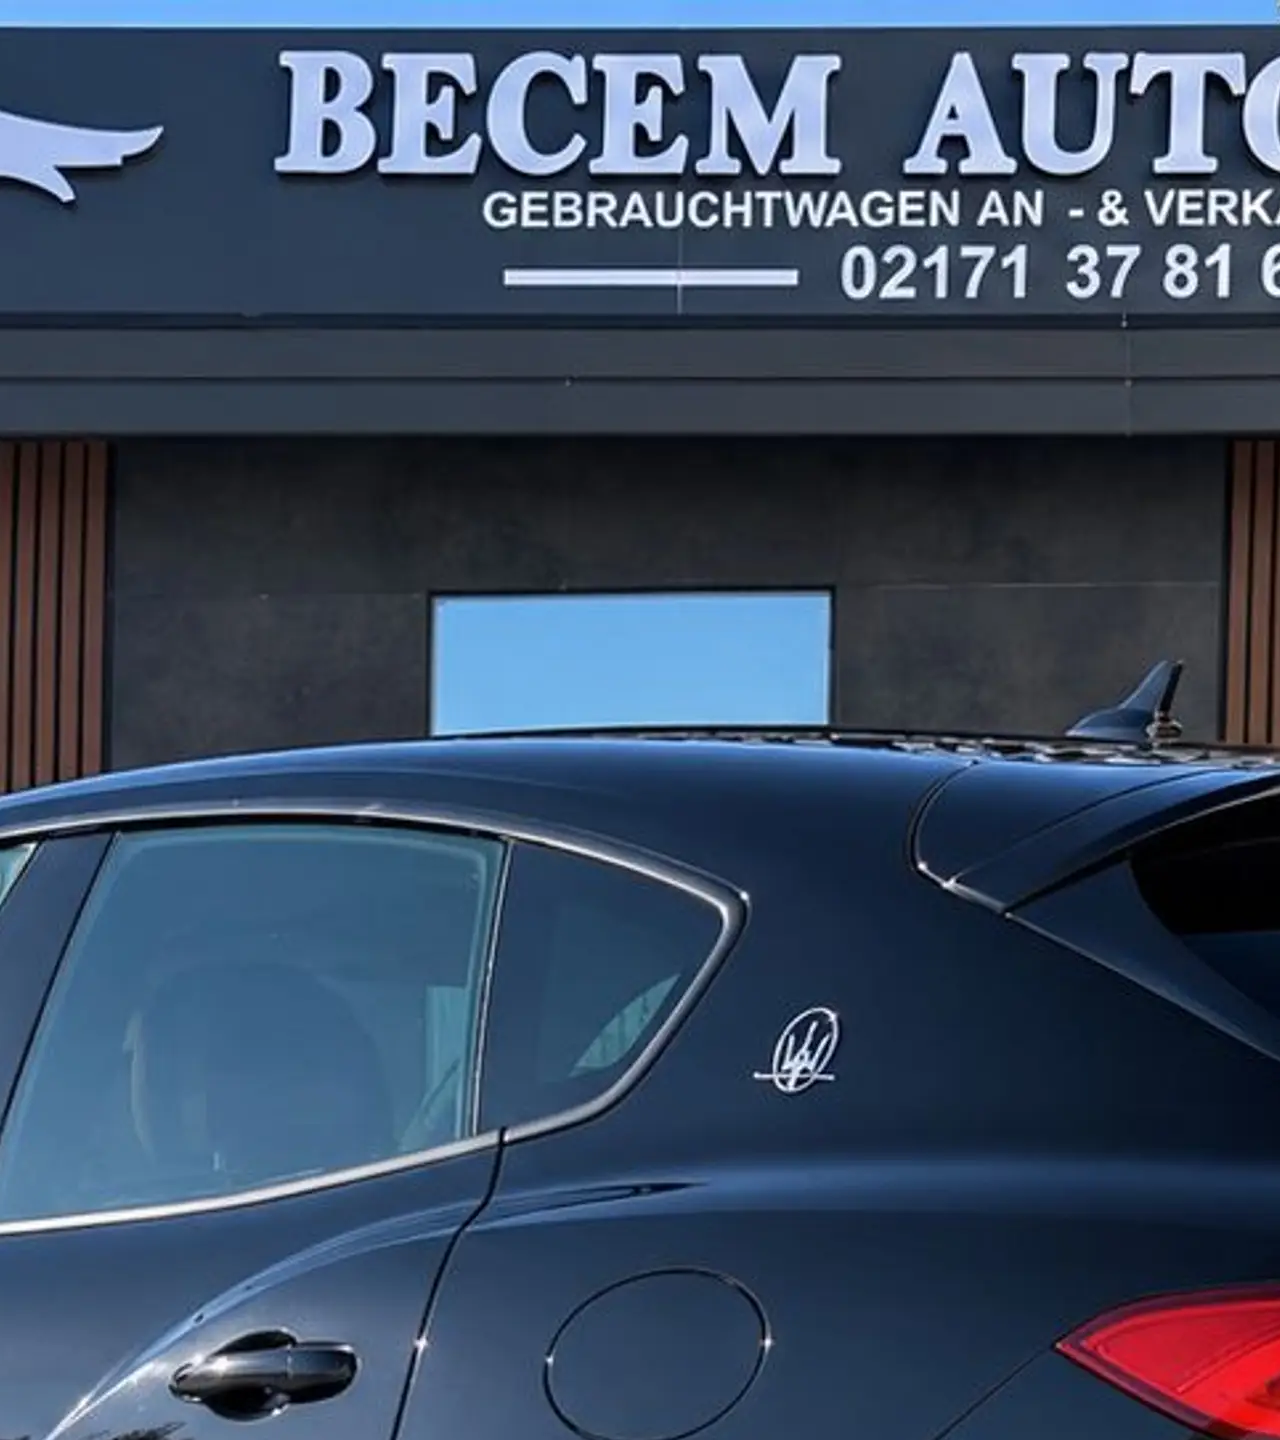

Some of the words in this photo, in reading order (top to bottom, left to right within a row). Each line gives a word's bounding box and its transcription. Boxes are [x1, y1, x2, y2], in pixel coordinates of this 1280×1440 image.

[274, 50, 842, 175] BECEM
[483, 190, 960, 229] GEBRAUCHTWAGEN
[977, 190, 1044, 227] AN
[841, 243, 1028, 300] 02171
[1065, 244, 1142, 299] 37
[1163, 243, 1231, 298] 81
